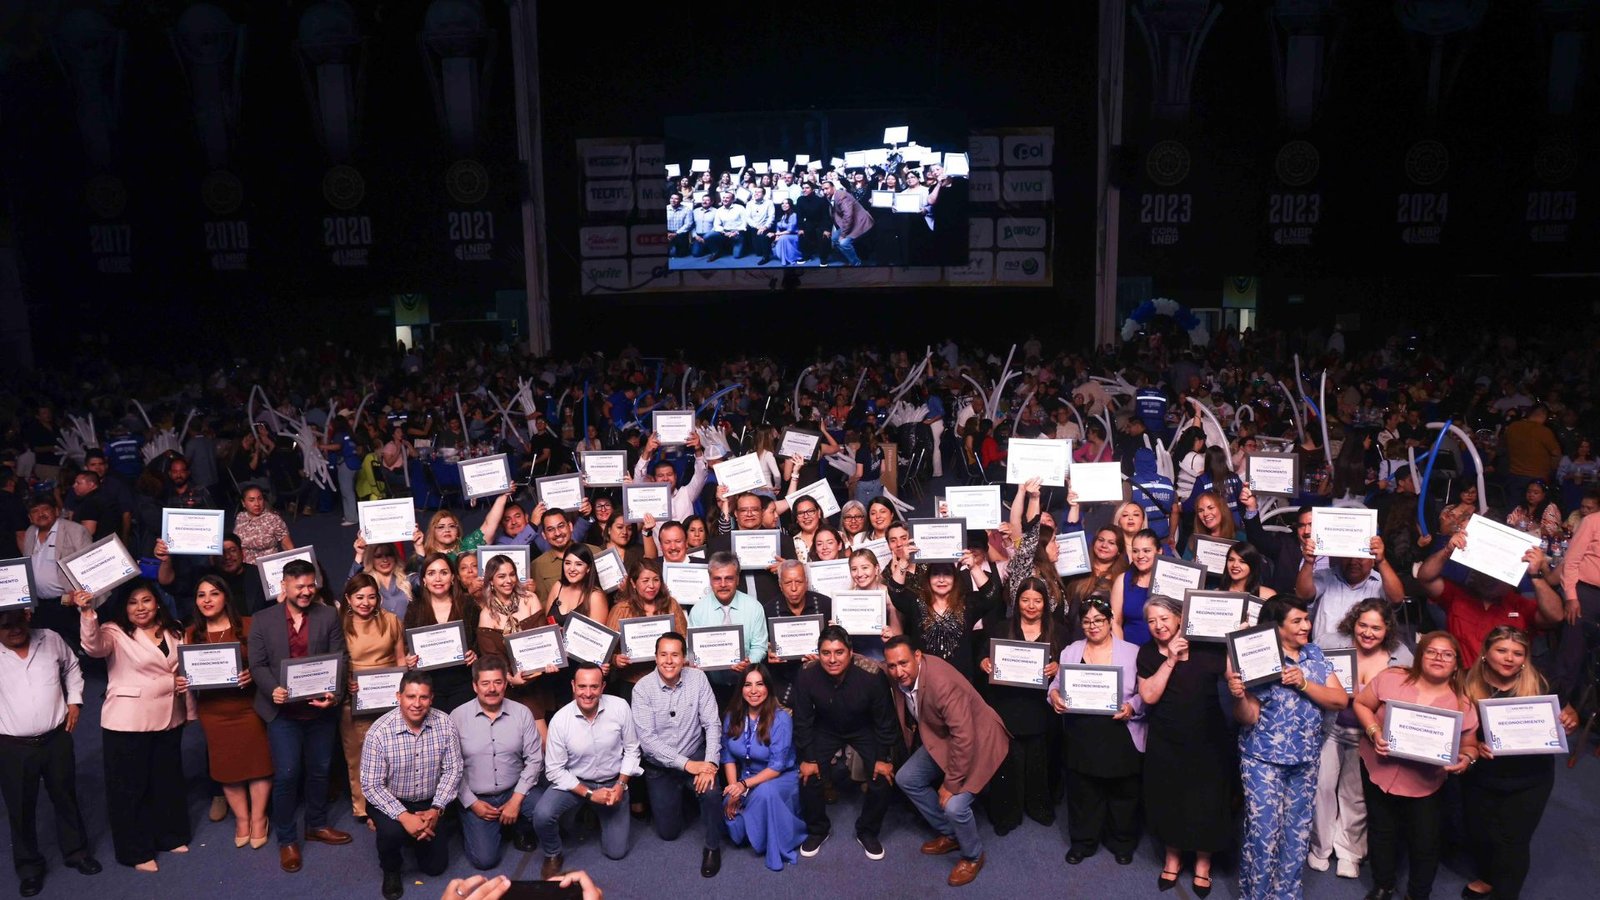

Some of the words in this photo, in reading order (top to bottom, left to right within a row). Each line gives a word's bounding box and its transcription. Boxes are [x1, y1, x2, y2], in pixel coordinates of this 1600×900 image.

[1141, 194, 1191, 223] 2023
[1269, 194, 1320, 223] 2023
[1397, 192, 1448, 223] 2024
[204, 221, 248, 251] 2019
[323, 216, 372, 245] 2020
[448, 211, 494, 240] 2021
[1152, 235, 1178, 244] LNBP
[1399, 723, 1444, 736] RECONOCIMIENTO
